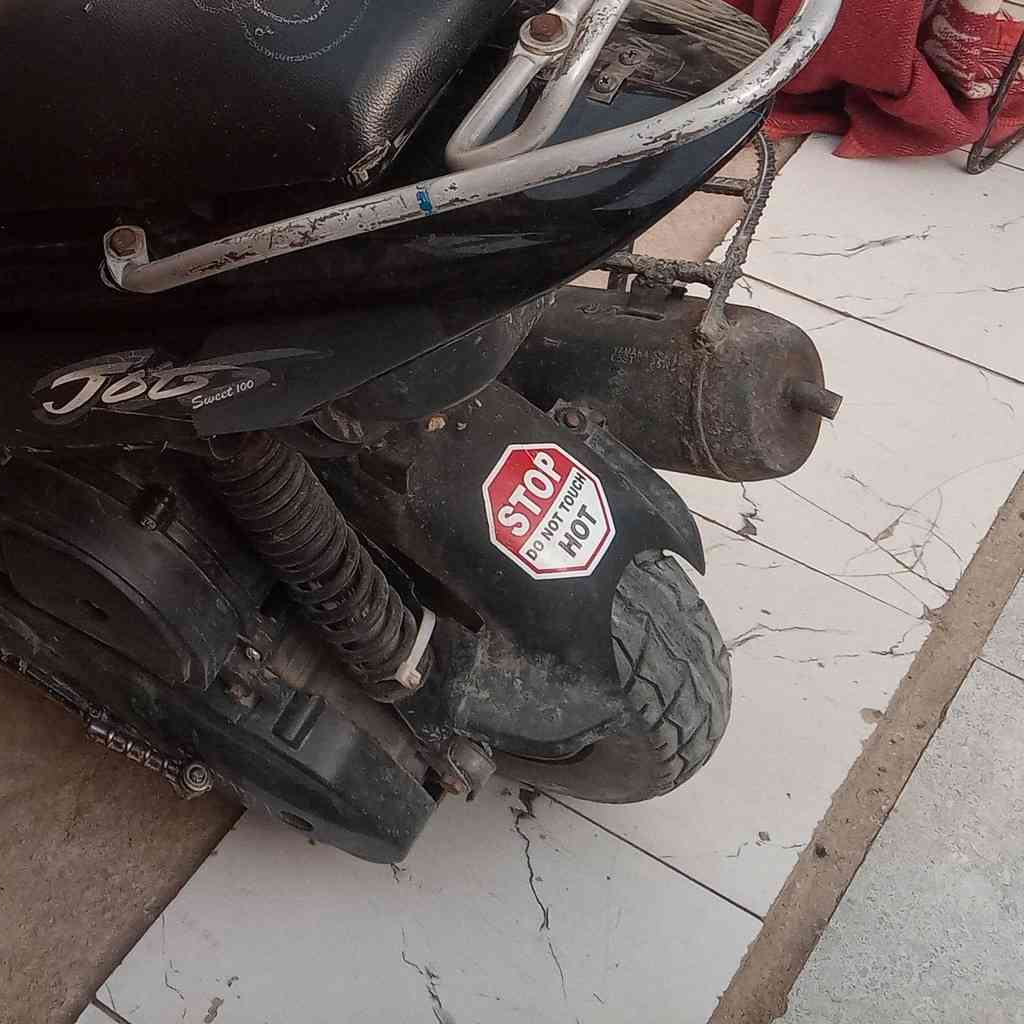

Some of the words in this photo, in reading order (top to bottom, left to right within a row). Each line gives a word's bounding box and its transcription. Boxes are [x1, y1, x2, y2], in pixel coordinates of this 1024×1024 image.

[191, 386, 234, 410] Sweet
[235, 379, 255, 394] 100
[497, 451, 562, 537] STOP
[525, 539, 544, 561] DO
[541, 511, 564, 541] NOT
[558, 471, 587, 513] TOUCH
[558, 504, 598, 558] HOT
